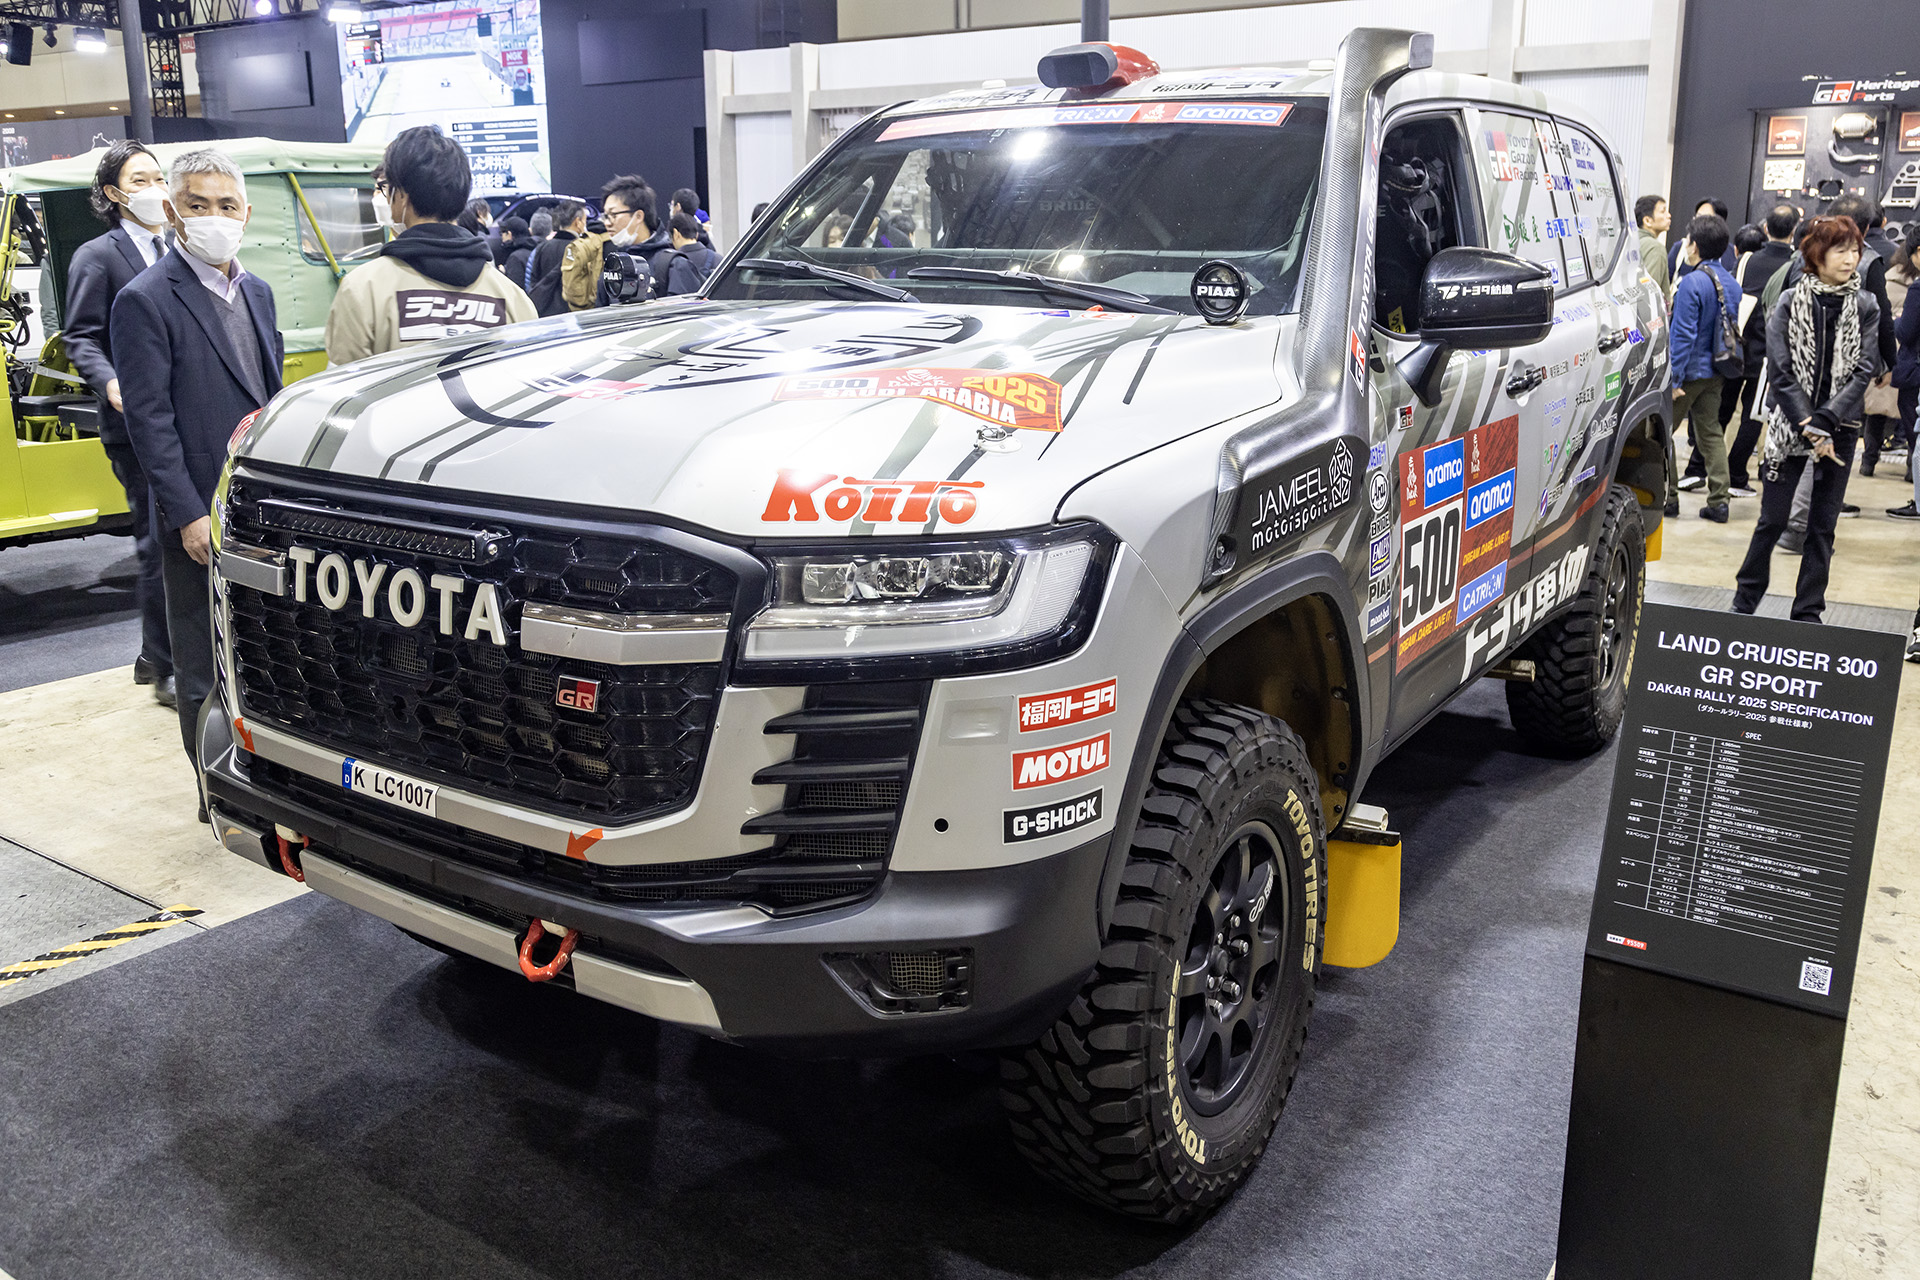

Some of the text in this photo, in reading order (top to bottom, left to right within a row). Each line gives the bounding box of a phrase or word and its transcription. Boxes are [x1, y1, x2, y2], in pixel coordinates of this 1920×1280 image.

[506, 51, 523, 62] NGK
[1815, 79, 1920, 102] GR Heritage
[1852, 92, 1895, 102] Parts
[1180, 107, 1280, 121] aramco
[1513, 167, 1539, 185] Racing
[404, 296, 500, 324] ランクル
[1197, 285, 1236, 297] PIAA
[796, 378, 869, 390] 500
[962, 375, 1048, 415] 2025
[823, 386, 1017, 425] SAUDI ARABIA
[1427, 458, 1462, 488] aramco
[1252, 467, 1328, 528] JAMEEL
[1471, 480, 1511, 519] aramco
[1402, 507, 1460, 628] 500
[289, 546, 506, 645] TOYOTA
[1369, 575, 1390, 604] PIAA
[1634, 566, 1644, 626] TOYO
[1460, 544, 1589, 684] トヨタ車体
[1657, 630, 1877, 678] LAND CRUISER 300
[559, 690, 594, 710] GR
[1700, 664, 1822, 698] GR SPORT
[1021, 684, 1116, 726] 福岡トヨタ
[1646, 680, 1873, 726] DAKAR RALLY 2025 SPECIFICATION
[1744, 731, 1761, 740] SPEC
[1018, 739, 1107, 784] MOTUL
[354, 766, 366, 789] K
[374, 772, 434, 810] LC1007
[1013, 796, 1098, 837] G-SHOCK
[1282, 789, 1318, 973] TOYO TIRES
